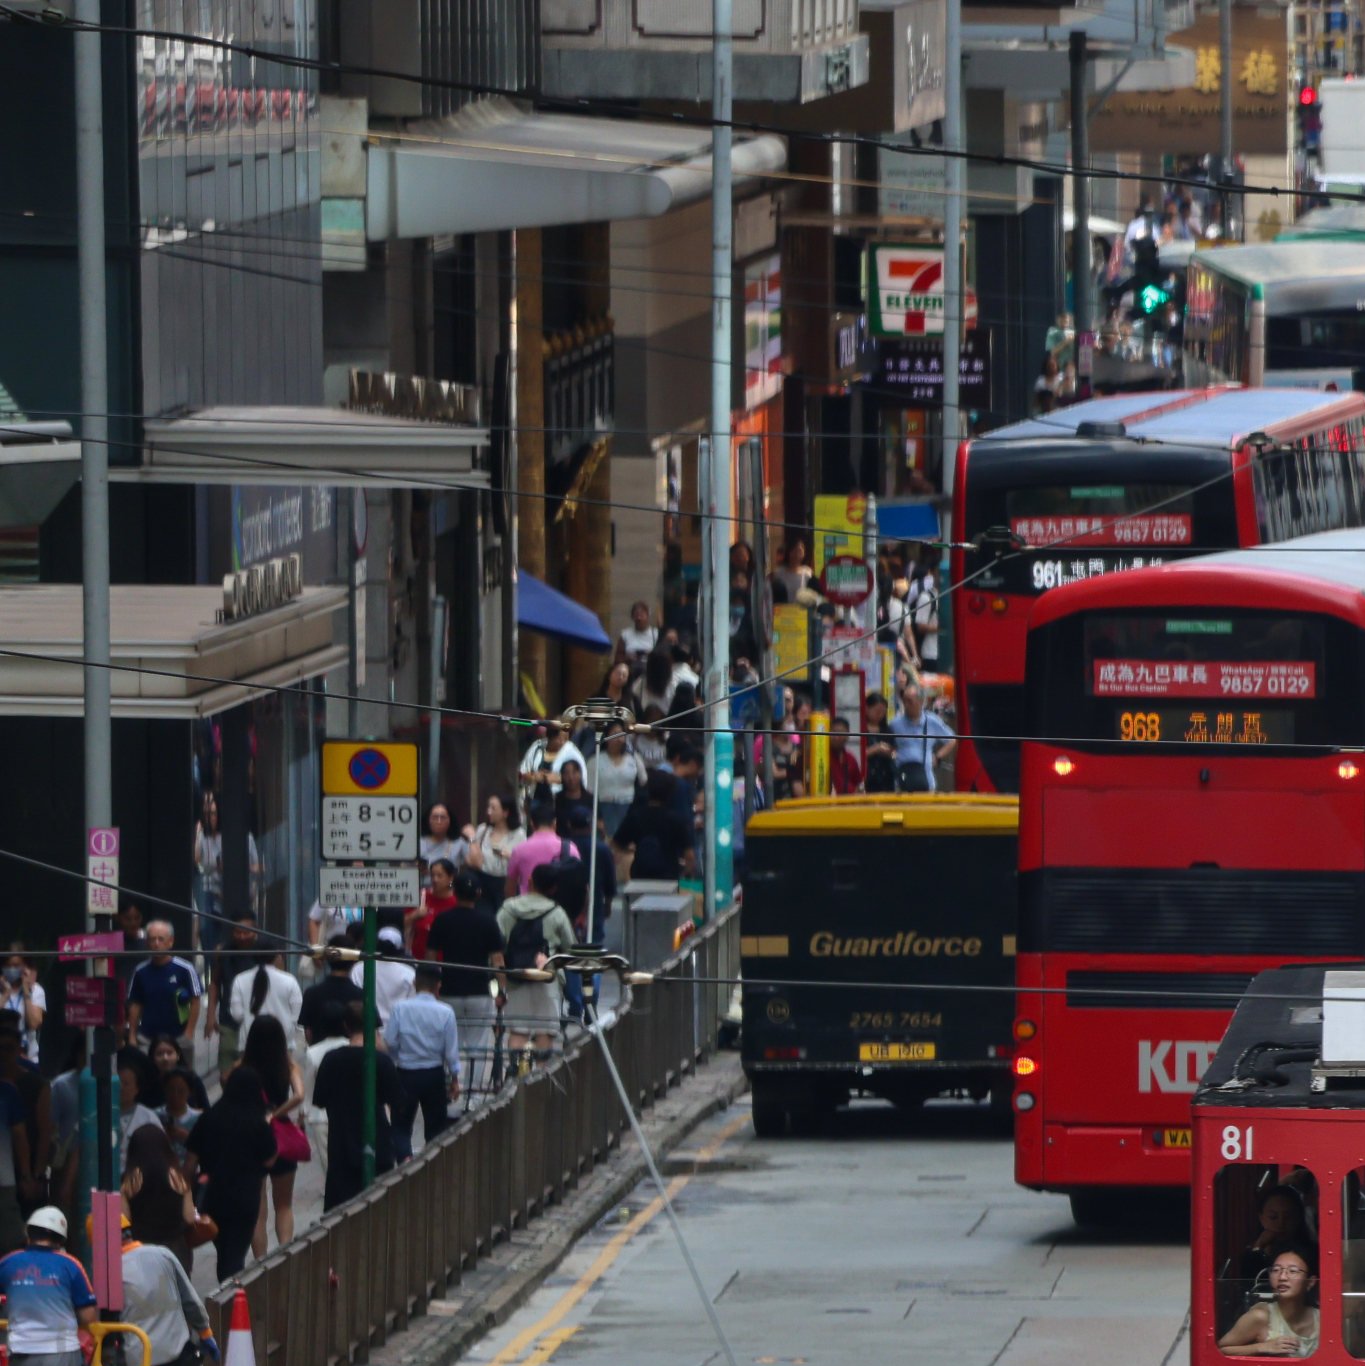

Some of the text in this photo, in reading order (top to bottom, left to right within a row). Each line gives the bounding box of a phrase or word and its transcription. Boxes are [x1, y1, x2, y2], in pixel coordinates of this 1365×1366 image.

[1032, 559, 1064, 589] 961
[1099, 664, 1208, 685] 成為九巴車長
[1220, 676, 1309, 694] 9857 0129
[1120, 711, 1161, 741] 968
[329, 813, 352, 825] 上午
[809, 931, 982, 957] Guardforce
[900, 1012, 943, 1028] 7654
[1221, 1125, 1253, 1161] 81
